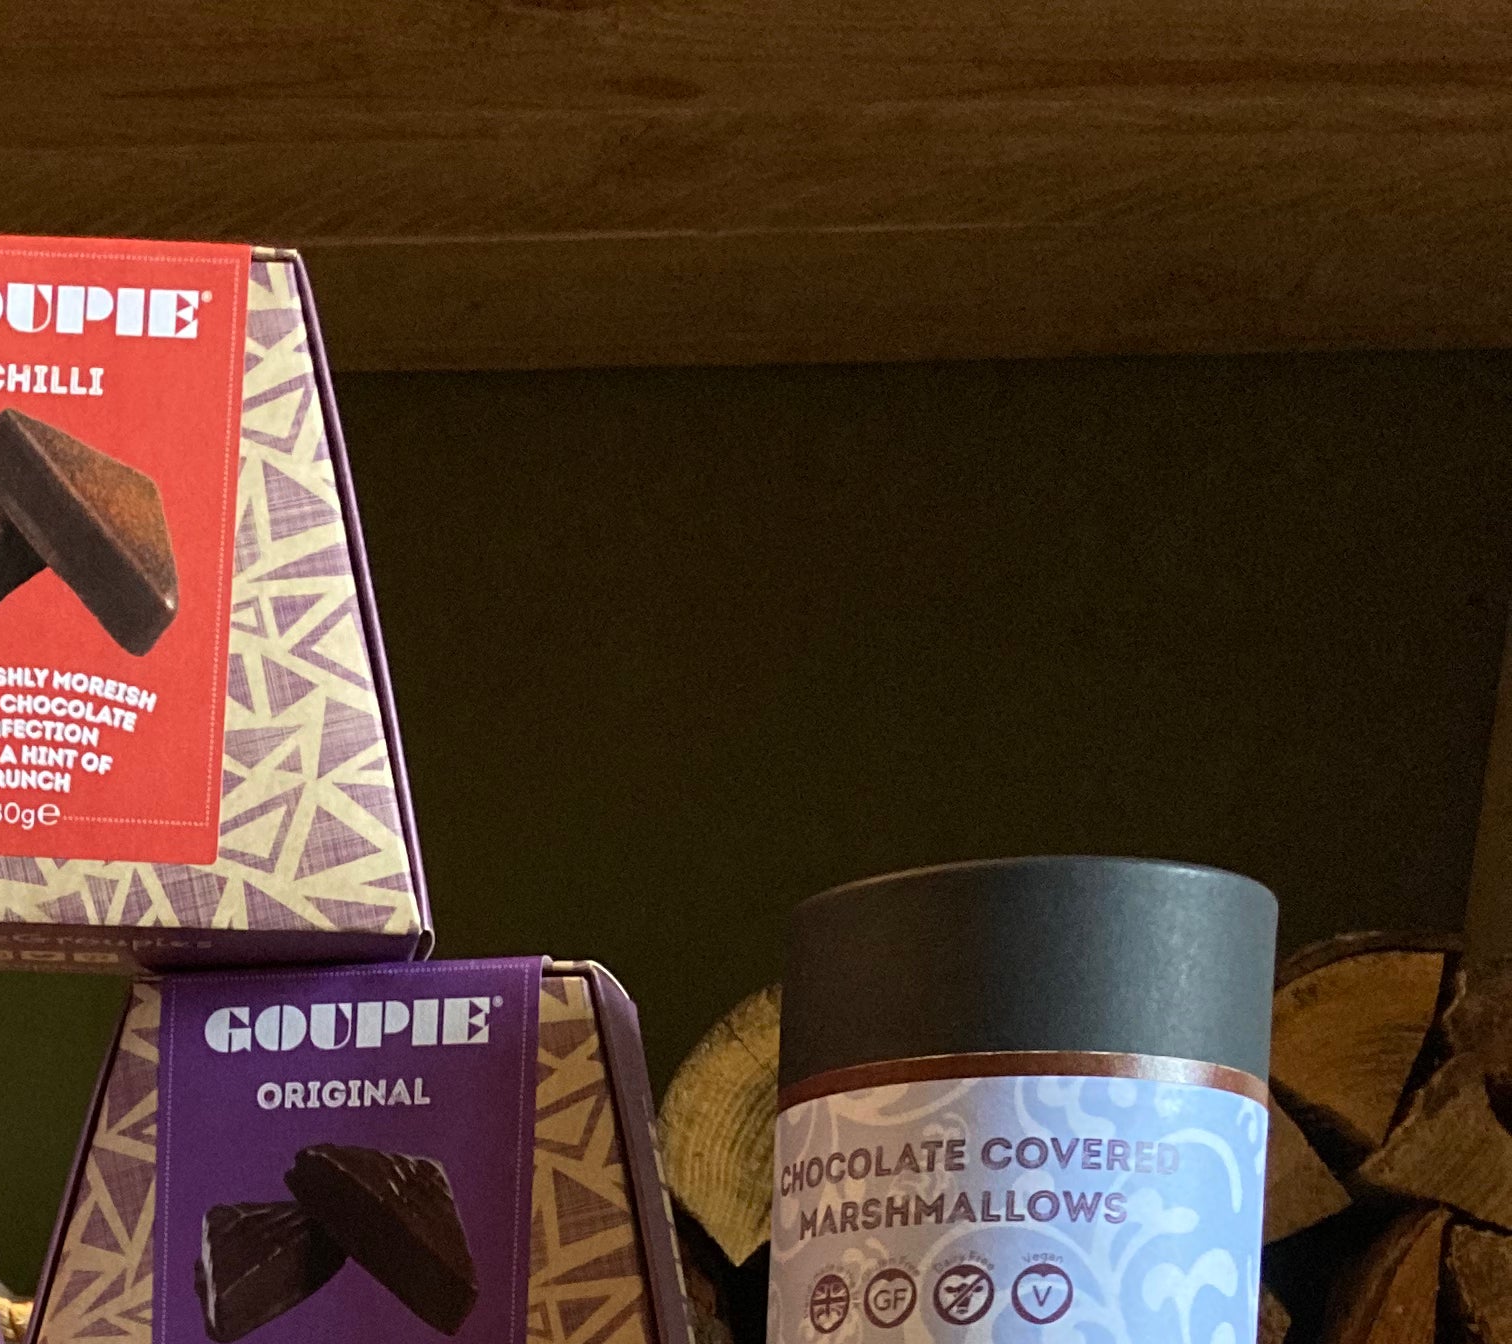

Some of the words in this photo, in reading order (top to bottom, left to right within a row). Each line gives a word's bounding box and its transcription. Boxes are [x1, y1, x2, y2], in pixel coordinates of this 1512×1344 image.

[52, 671, 157, 710] MOREISH
[0, 694, 136, 732] CHOCOLATE
[0, 747, 16, 764] A
[21, 748, 75, 770] HINT
[80, 752, 112, 775] OF
[257, 1078, 430, 1109] ORIGINAL
[780, 1138, 967, 1198] CHOCOLATE
[981, 1137, 1180, 1175] COVERED
[799, 1190, 1128, 1241] MARSHMALLOWS
[1023, 1252, 1064, 1265] Vegan
[874, 1288, 907, 1312] GF
[1032, 1285, 1052, 1308] V
